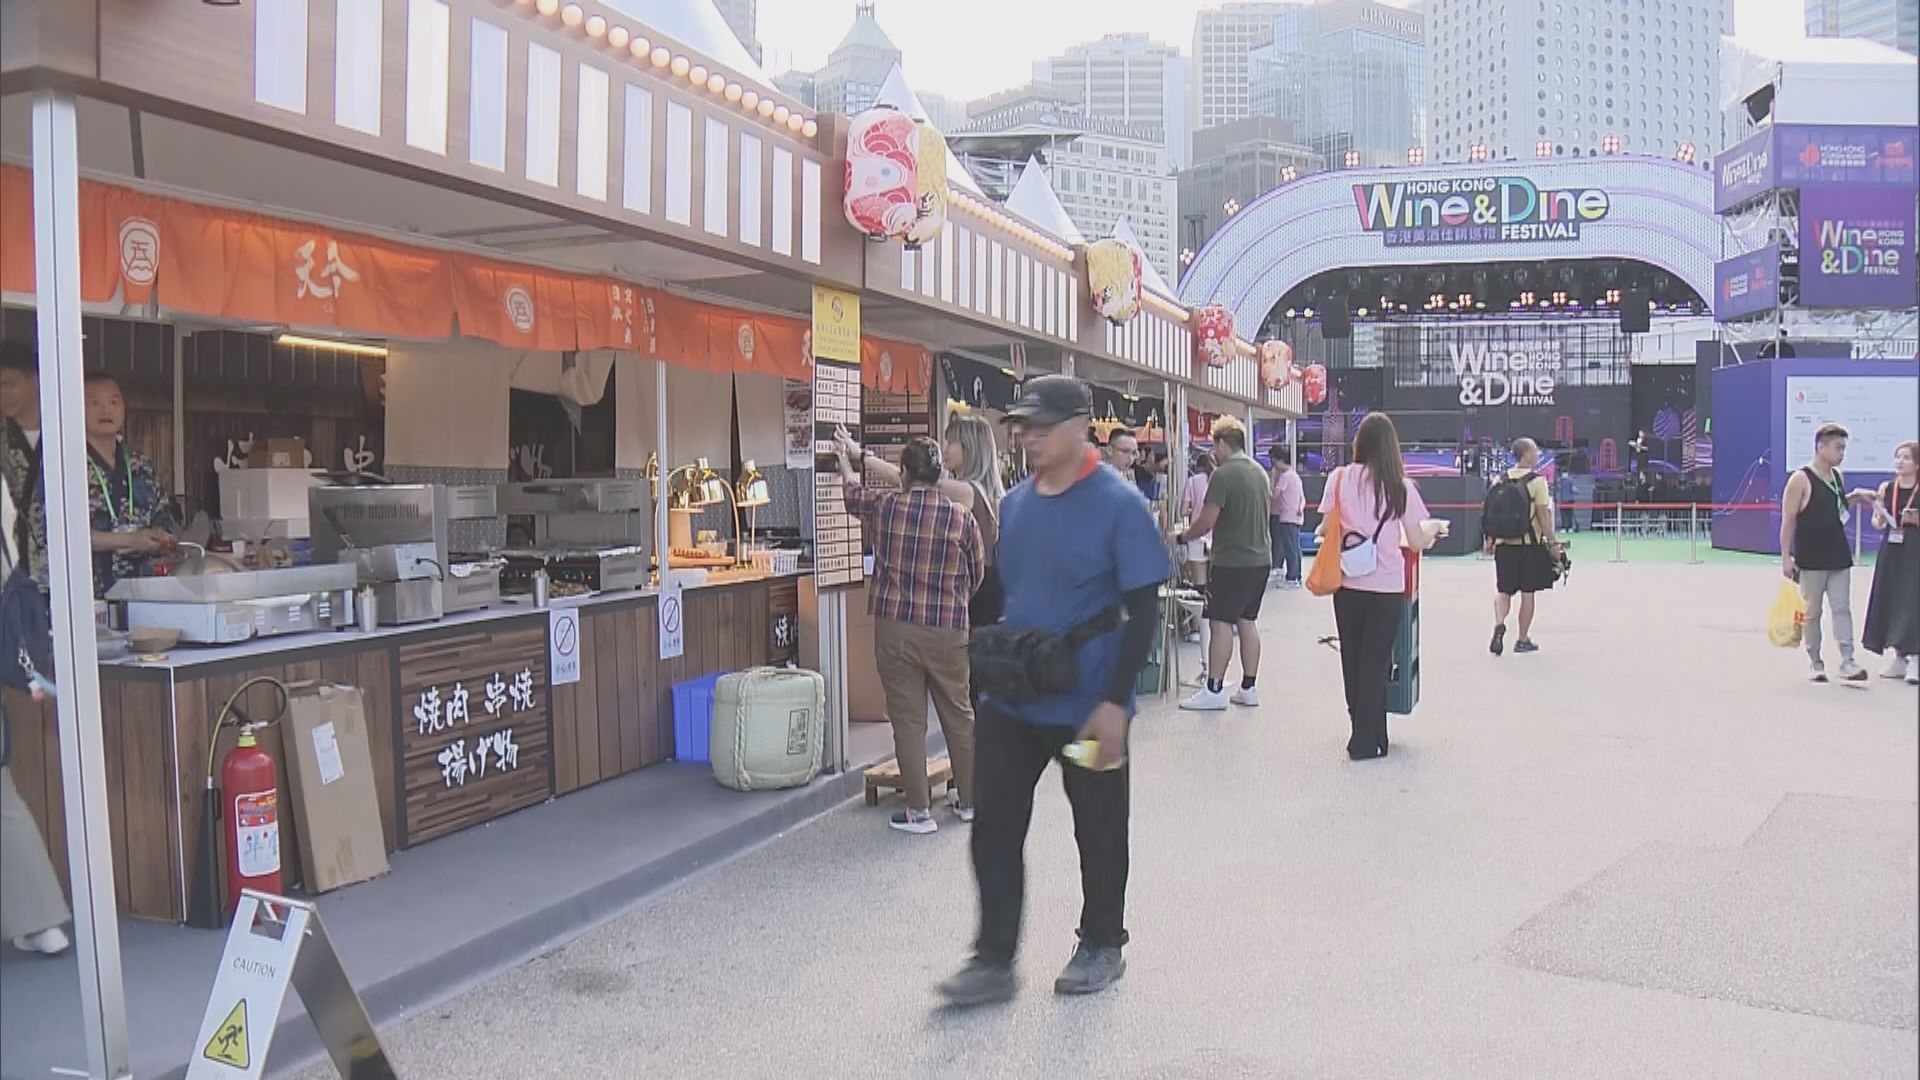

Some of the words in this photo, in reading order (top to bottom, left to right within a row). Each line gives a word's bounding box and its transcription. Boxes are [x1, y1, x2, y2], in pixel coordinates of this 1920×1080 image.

[1407, 179, 1449, 195] HONG
[1452, 177, 1496, 192] KONG
[1501, 223, 1577, 240] FESTIVAL
[1811, 219, 1877, 248] Wine
[1864, 266, 1900, 275] FESTIVAL
[1449, 342, 1528, 375] Wine
[1529, 352, 1560, 360] HONG
[1511, 396, 1555, 405] FESTIVAL
[233, 957, 276, 977] CAUTION
